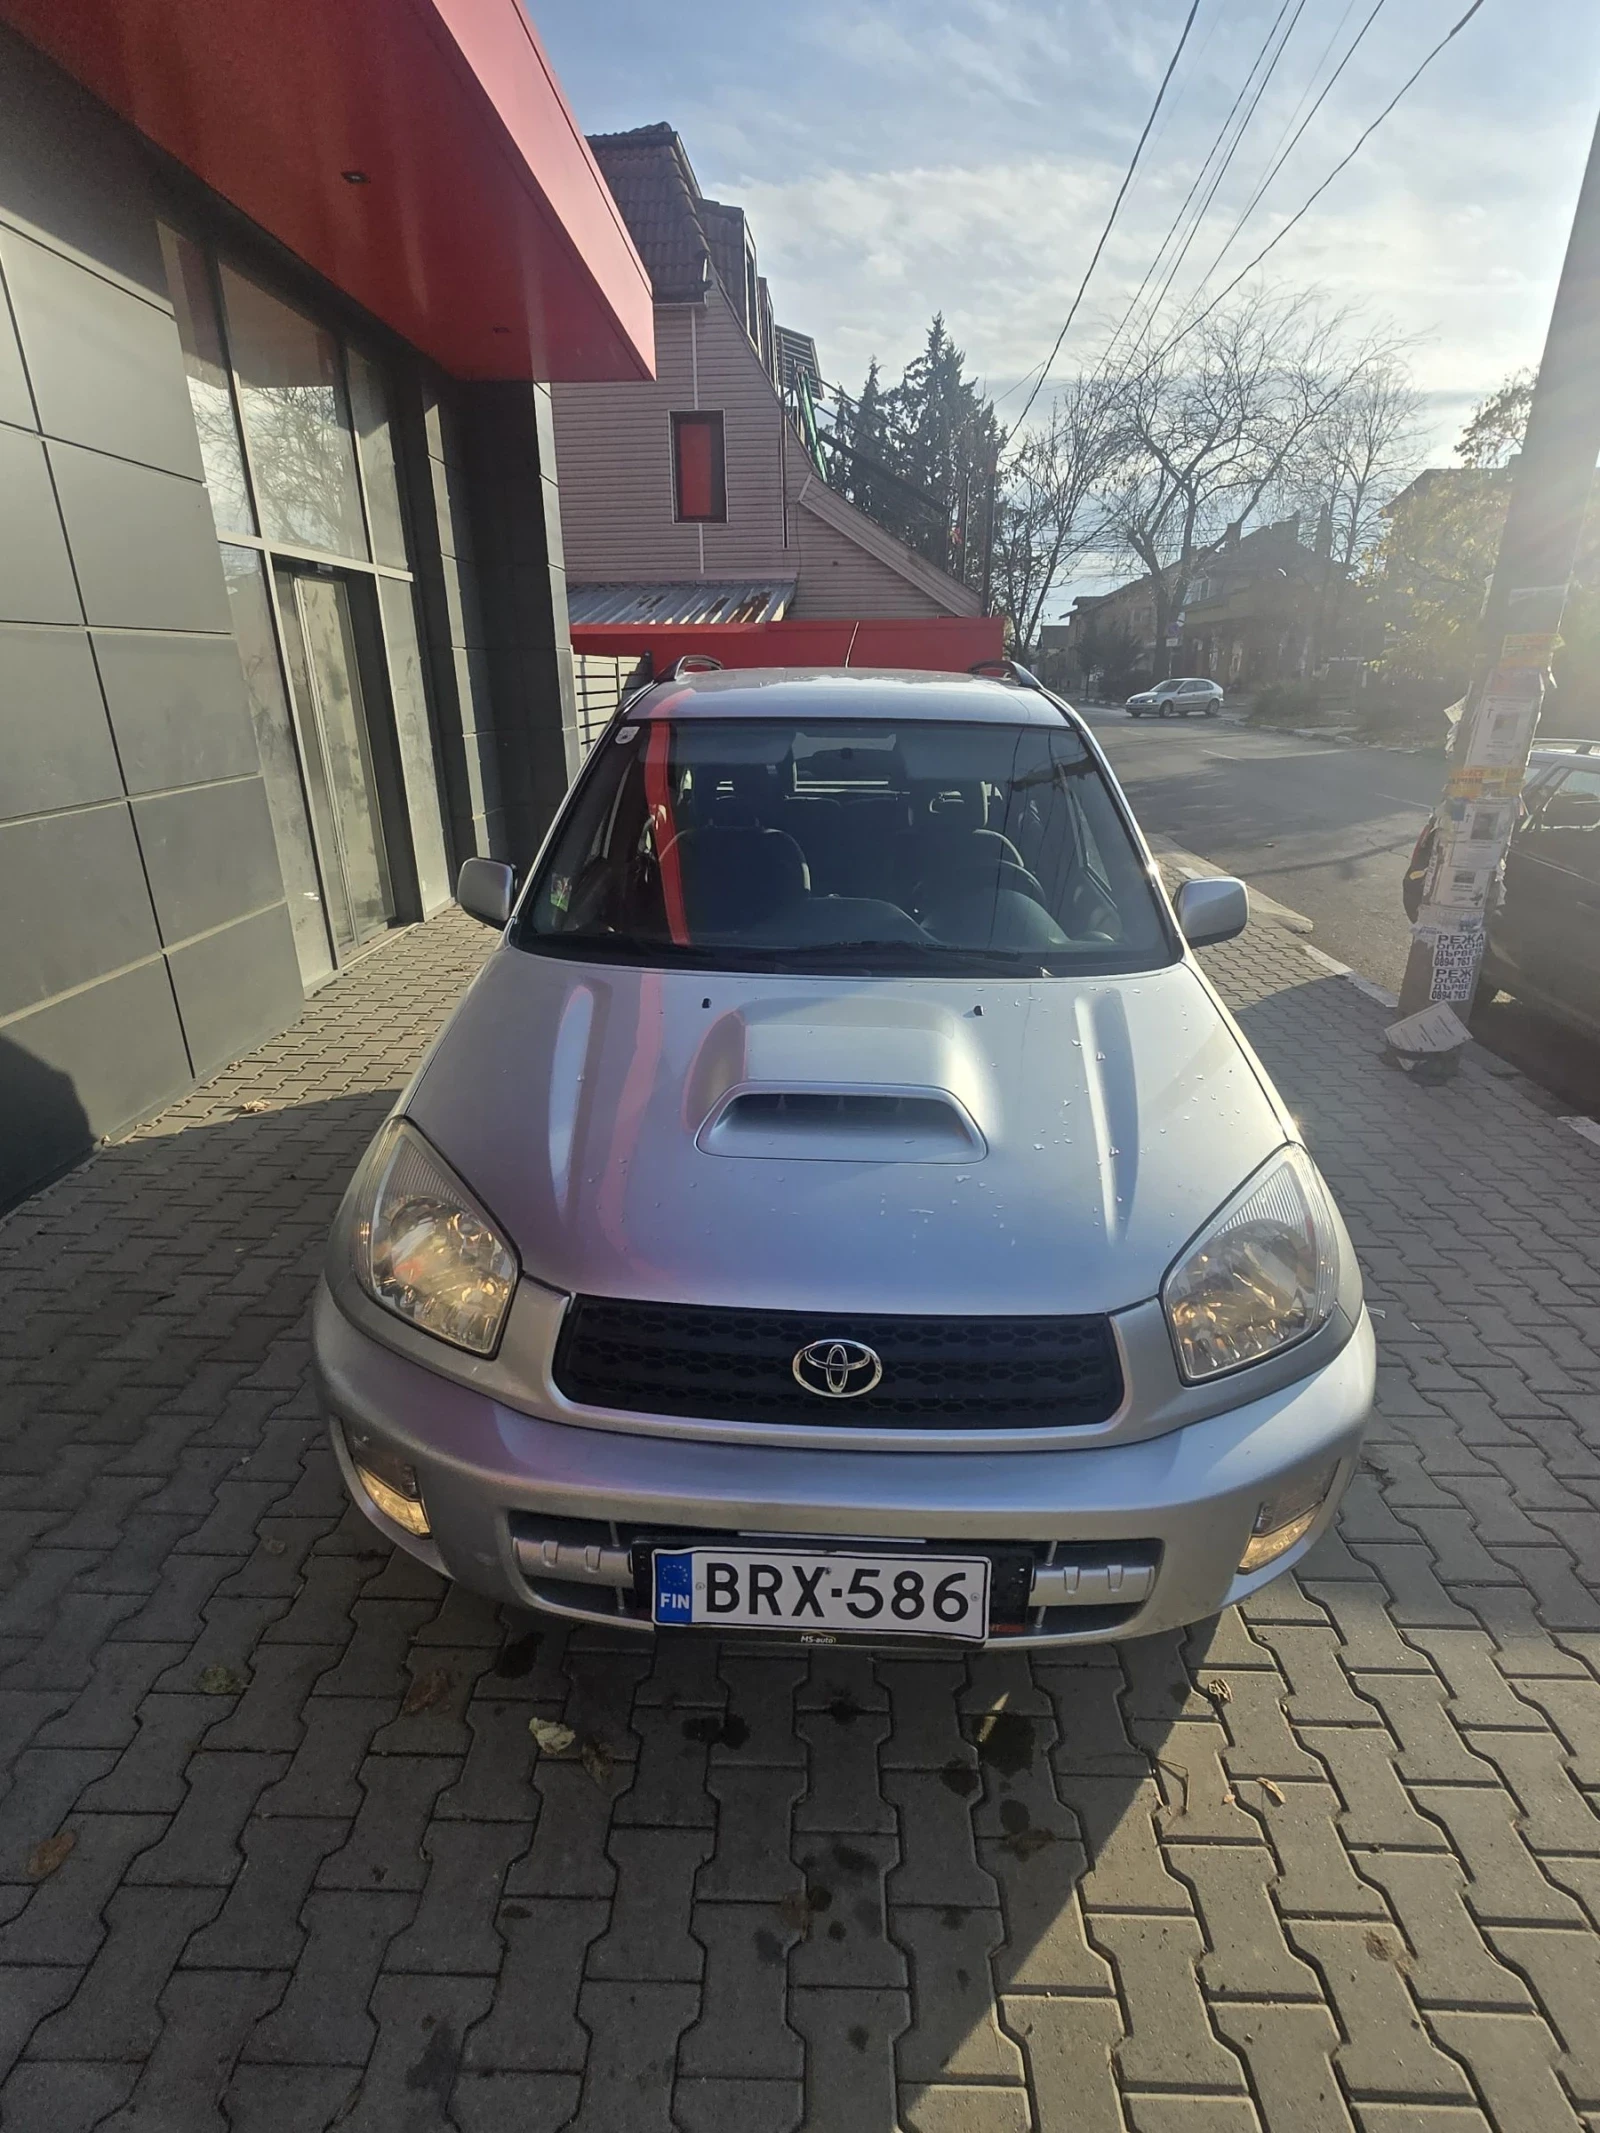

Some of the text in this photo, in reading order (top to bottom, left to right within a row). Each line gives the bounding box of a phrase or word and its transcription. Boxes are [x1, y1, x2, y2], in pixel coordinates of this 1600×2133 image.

[1438, 933, 1483, 944] РЕЖА
[660, 1592, 690, 1609] FIN
[706, 1563, 969, 1622] BRX-586
